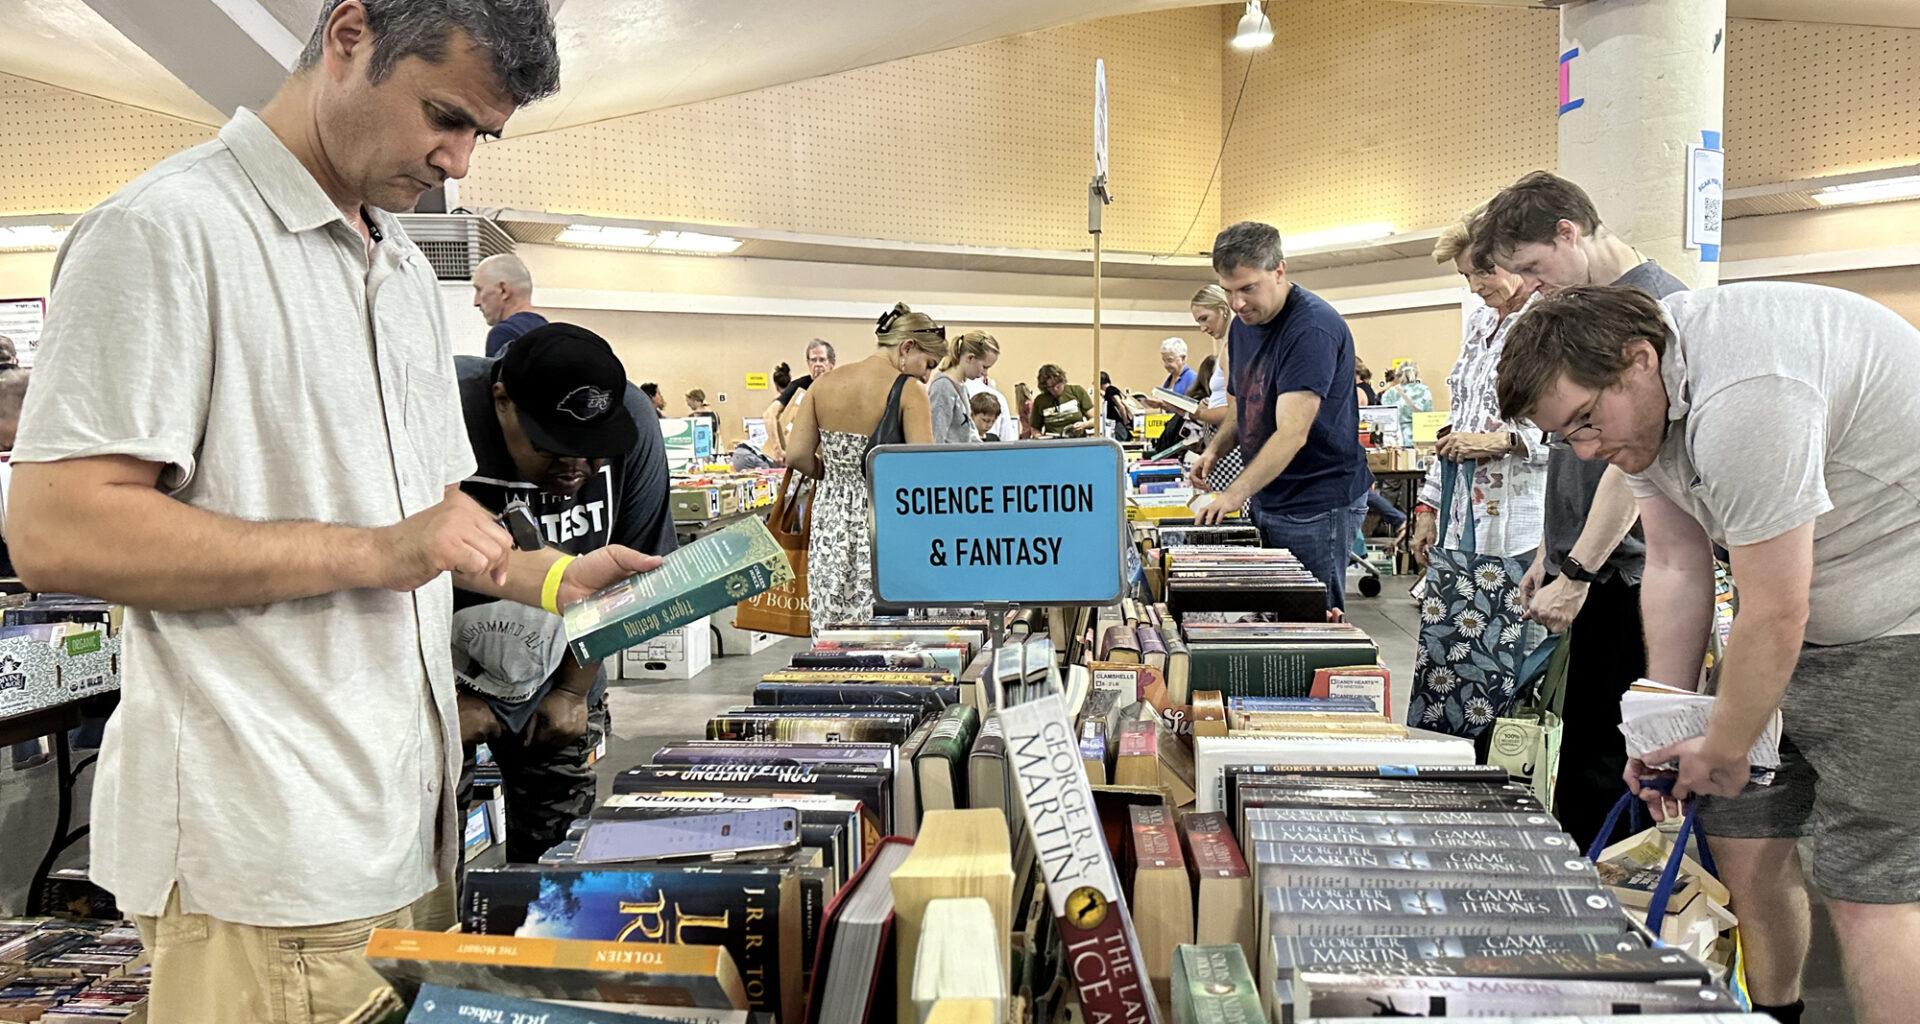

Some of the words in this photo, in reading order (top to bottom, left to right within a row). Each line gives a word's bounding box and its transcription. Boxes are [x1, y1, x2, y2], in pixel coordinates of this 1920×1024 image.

[896, 486, 994, 515] SCIENCE
[1002, 484, 1093, 513] FICTION
[541, 501, 604, 543] TEST
[929, 538, 948, 567] &
[956, 537, 1062, 566] FANTASY
[752, 564, 767, 589] COLLEEN
[770, 580, 796, 594] AG
[1042, 721, 1089, 824] GEORGE
[635, 795, 753, 804] CHAMPION
[1010, 733, 1081, 884] MARTIN
[1283, 833, 1367, 844] MARTIN
[1434, 829, 1491, 840] GAME
[1291, 853, 1379, 867] MARTIN
[1449, 852, 1508, 864] GAME
[1298, 887, 1358, 899] GEORGE
[1465, 888, 1527, 902] GAME
[1300, 899, 1393, 914] MARTIN
[1461, 901, 1552, 915] THRONES
[1308, 936, 1372, 949] GEORGE
[1486, 935, 1549, 950] GAME
[596, 950, 664, 965] TOLKIEN
[1104, 929, 1133, 978] THE
[1313, 949, 1409, 963] MARTIN
[1067, 937, 1113, 1004] ICE
[459, 1005, 506, 1023] Tolkien
